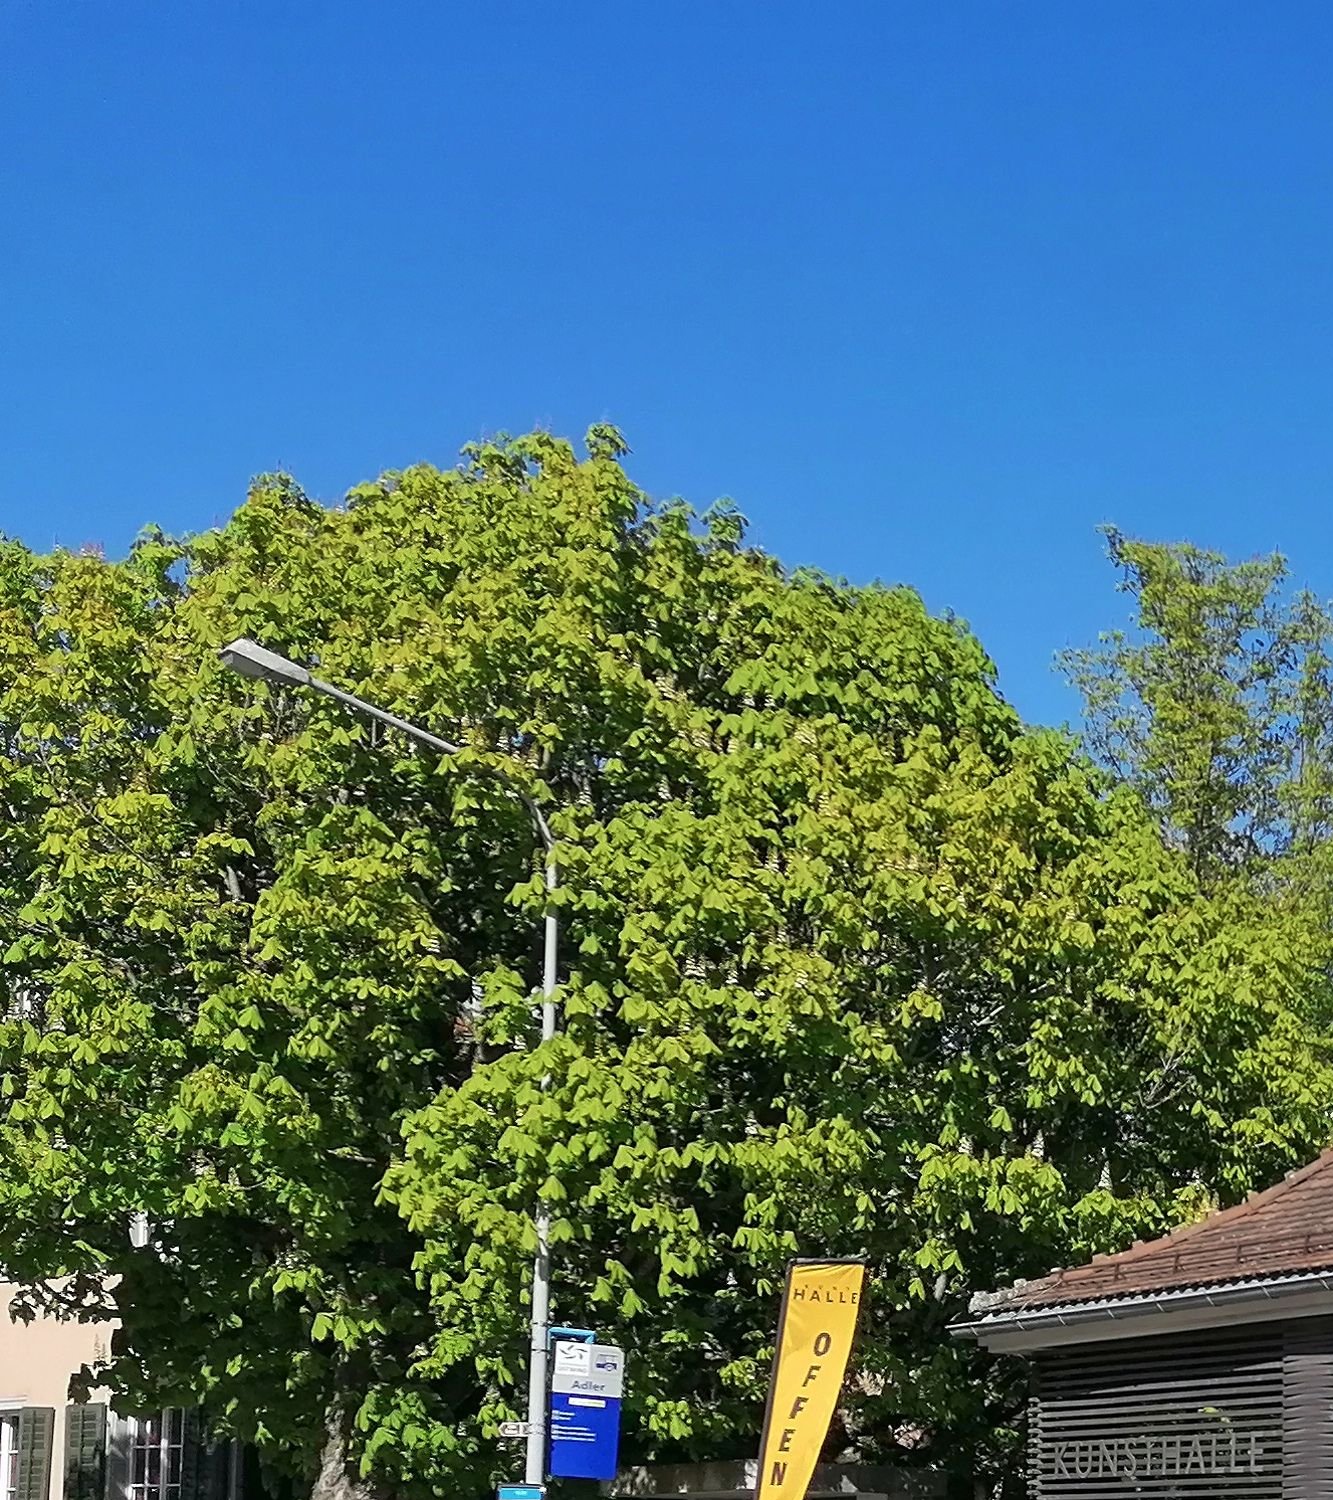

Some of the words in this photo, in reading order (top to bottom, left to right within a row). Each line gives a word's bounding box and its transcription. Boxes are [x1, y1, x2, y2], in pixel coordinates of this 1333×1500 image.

[793, 1288, 858, 1305] HALLE
[571, 1380, 606, 1391] Adler
[770, 1332, 832, 1486] OFFEN
[1053, 1431, 1264, 1480] KUNSTHALLE
